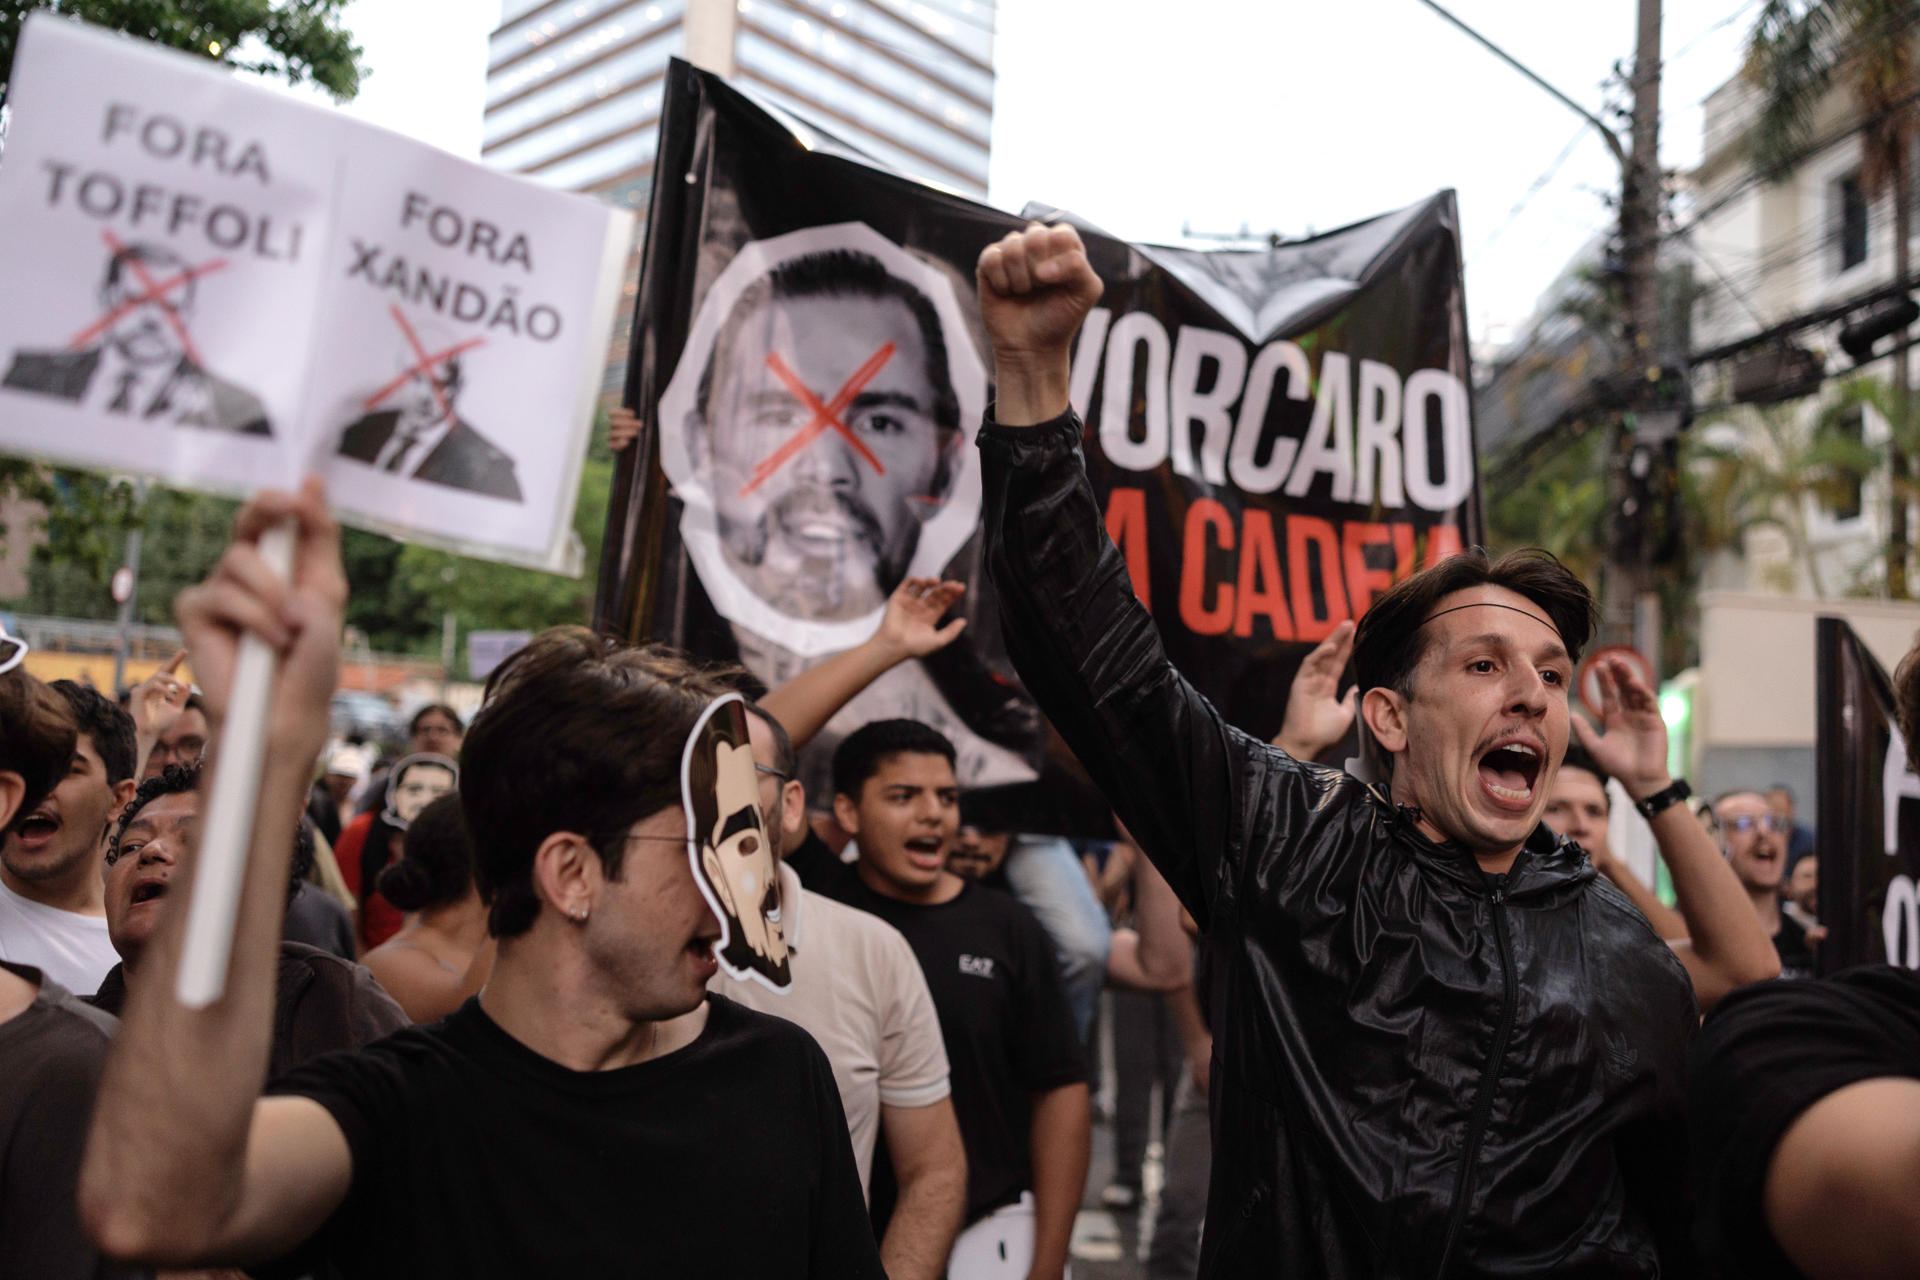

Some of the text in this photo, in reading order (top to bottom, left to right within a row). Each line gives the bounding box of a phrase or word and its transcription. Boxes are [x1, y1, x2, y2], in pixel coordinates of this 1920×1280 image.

[102, 102, 271, 184] FORA
[41, 158, 303, 264] TOFFOLI
[401, 189, 533, 273] FORA
[347, 239, 562, 342] XANDÃO
[1179, 497, 1463, 643] CADE
